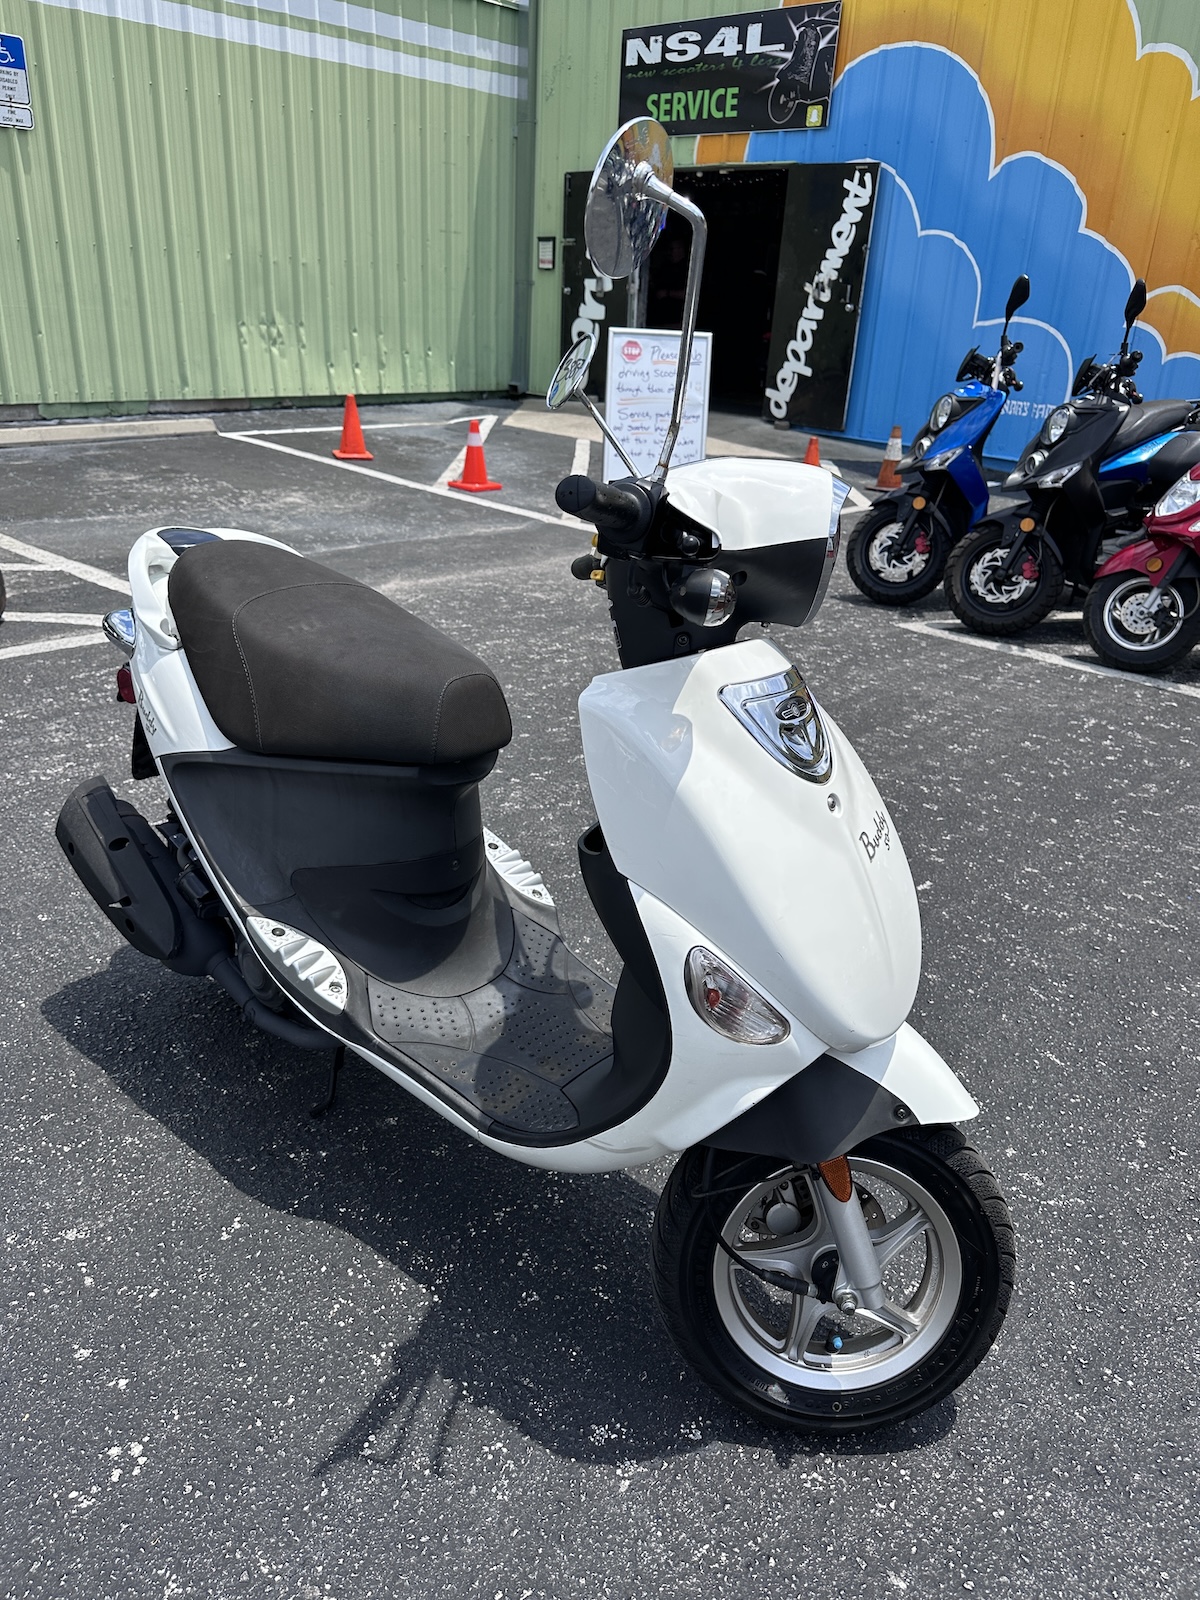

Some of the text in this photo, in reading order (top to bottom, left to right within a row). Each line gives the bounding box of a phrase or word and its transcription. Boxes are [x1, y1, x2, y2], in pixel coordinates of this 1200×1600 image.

[624, 23, 785, 67] NS4L
[625, 53, 785, 81] new scooters 4 less
[645, 86, 740, 123] SERVICE
[764, 169, 873, 420] department
[623, 346, 641, 356] STOP
[618, 365, 650, 382] driving
[138, 688, 157, 736] Buddy
[858, 810, 890, 864] Buddy
